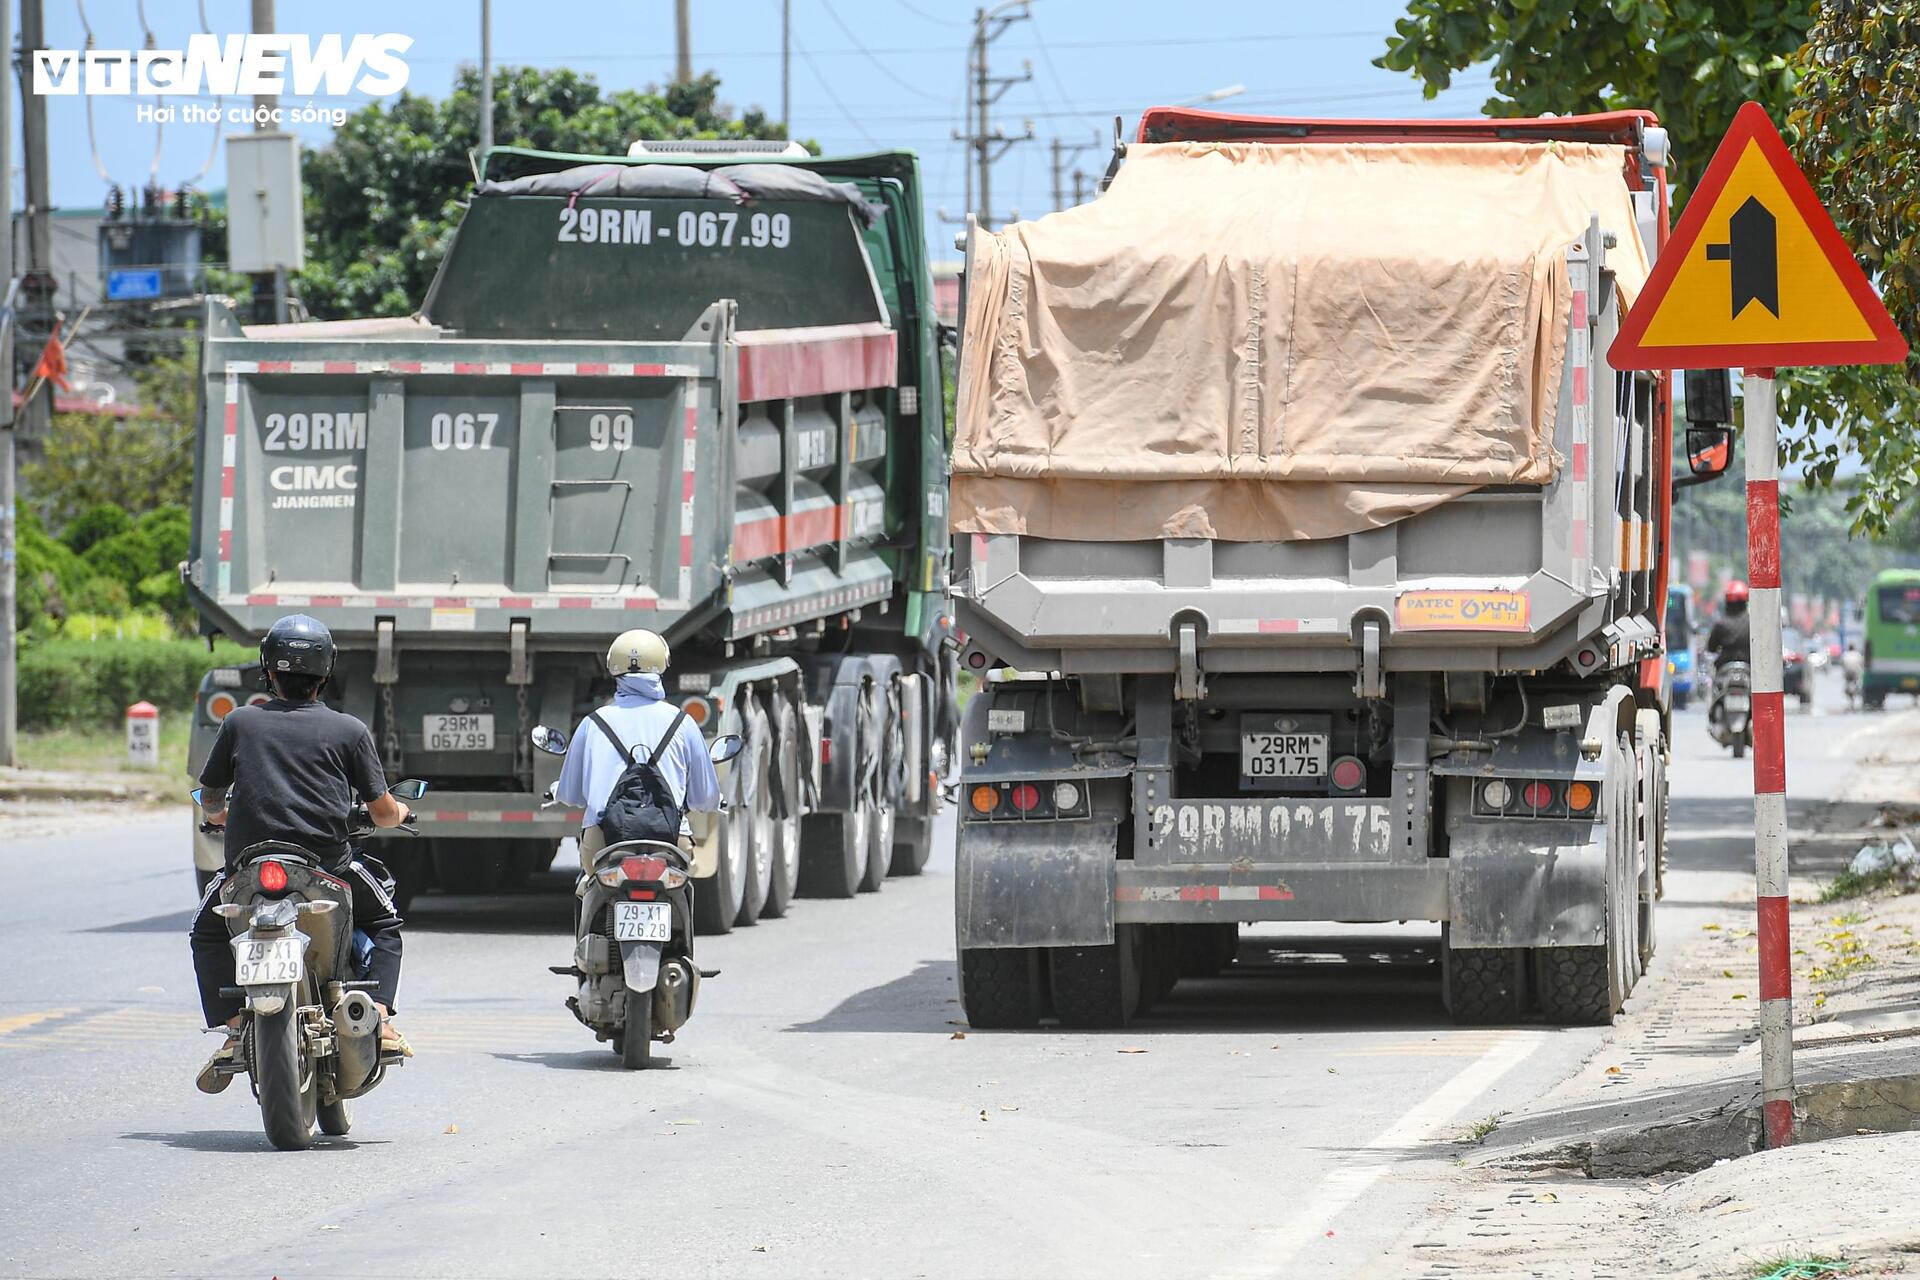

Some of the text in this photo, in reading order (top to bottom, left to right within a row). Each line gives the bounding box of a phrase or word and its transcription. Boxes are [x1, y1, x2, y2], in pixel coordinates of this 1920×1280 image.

[264, 412, 634, 452] 29RM 067 99
[269, 465, 358, 491] CIMC
[271, 494, 356, 509] JIANGMEN
[1406, 598, 1454, 609] PATEC
[438, 716, 480, 732] 29RM
[431, 733, 487, 749] 067.99
[1260, 736, 1310, 754] 29RM
[1251, 756, 1319, 775] 031.75
[623, 905, 662, 921] 29-X1
[618, 922, 667, 938] 726.28
[246, 941, 292, 961] 29-X1
[240, 961, 298, 982] 971.29
